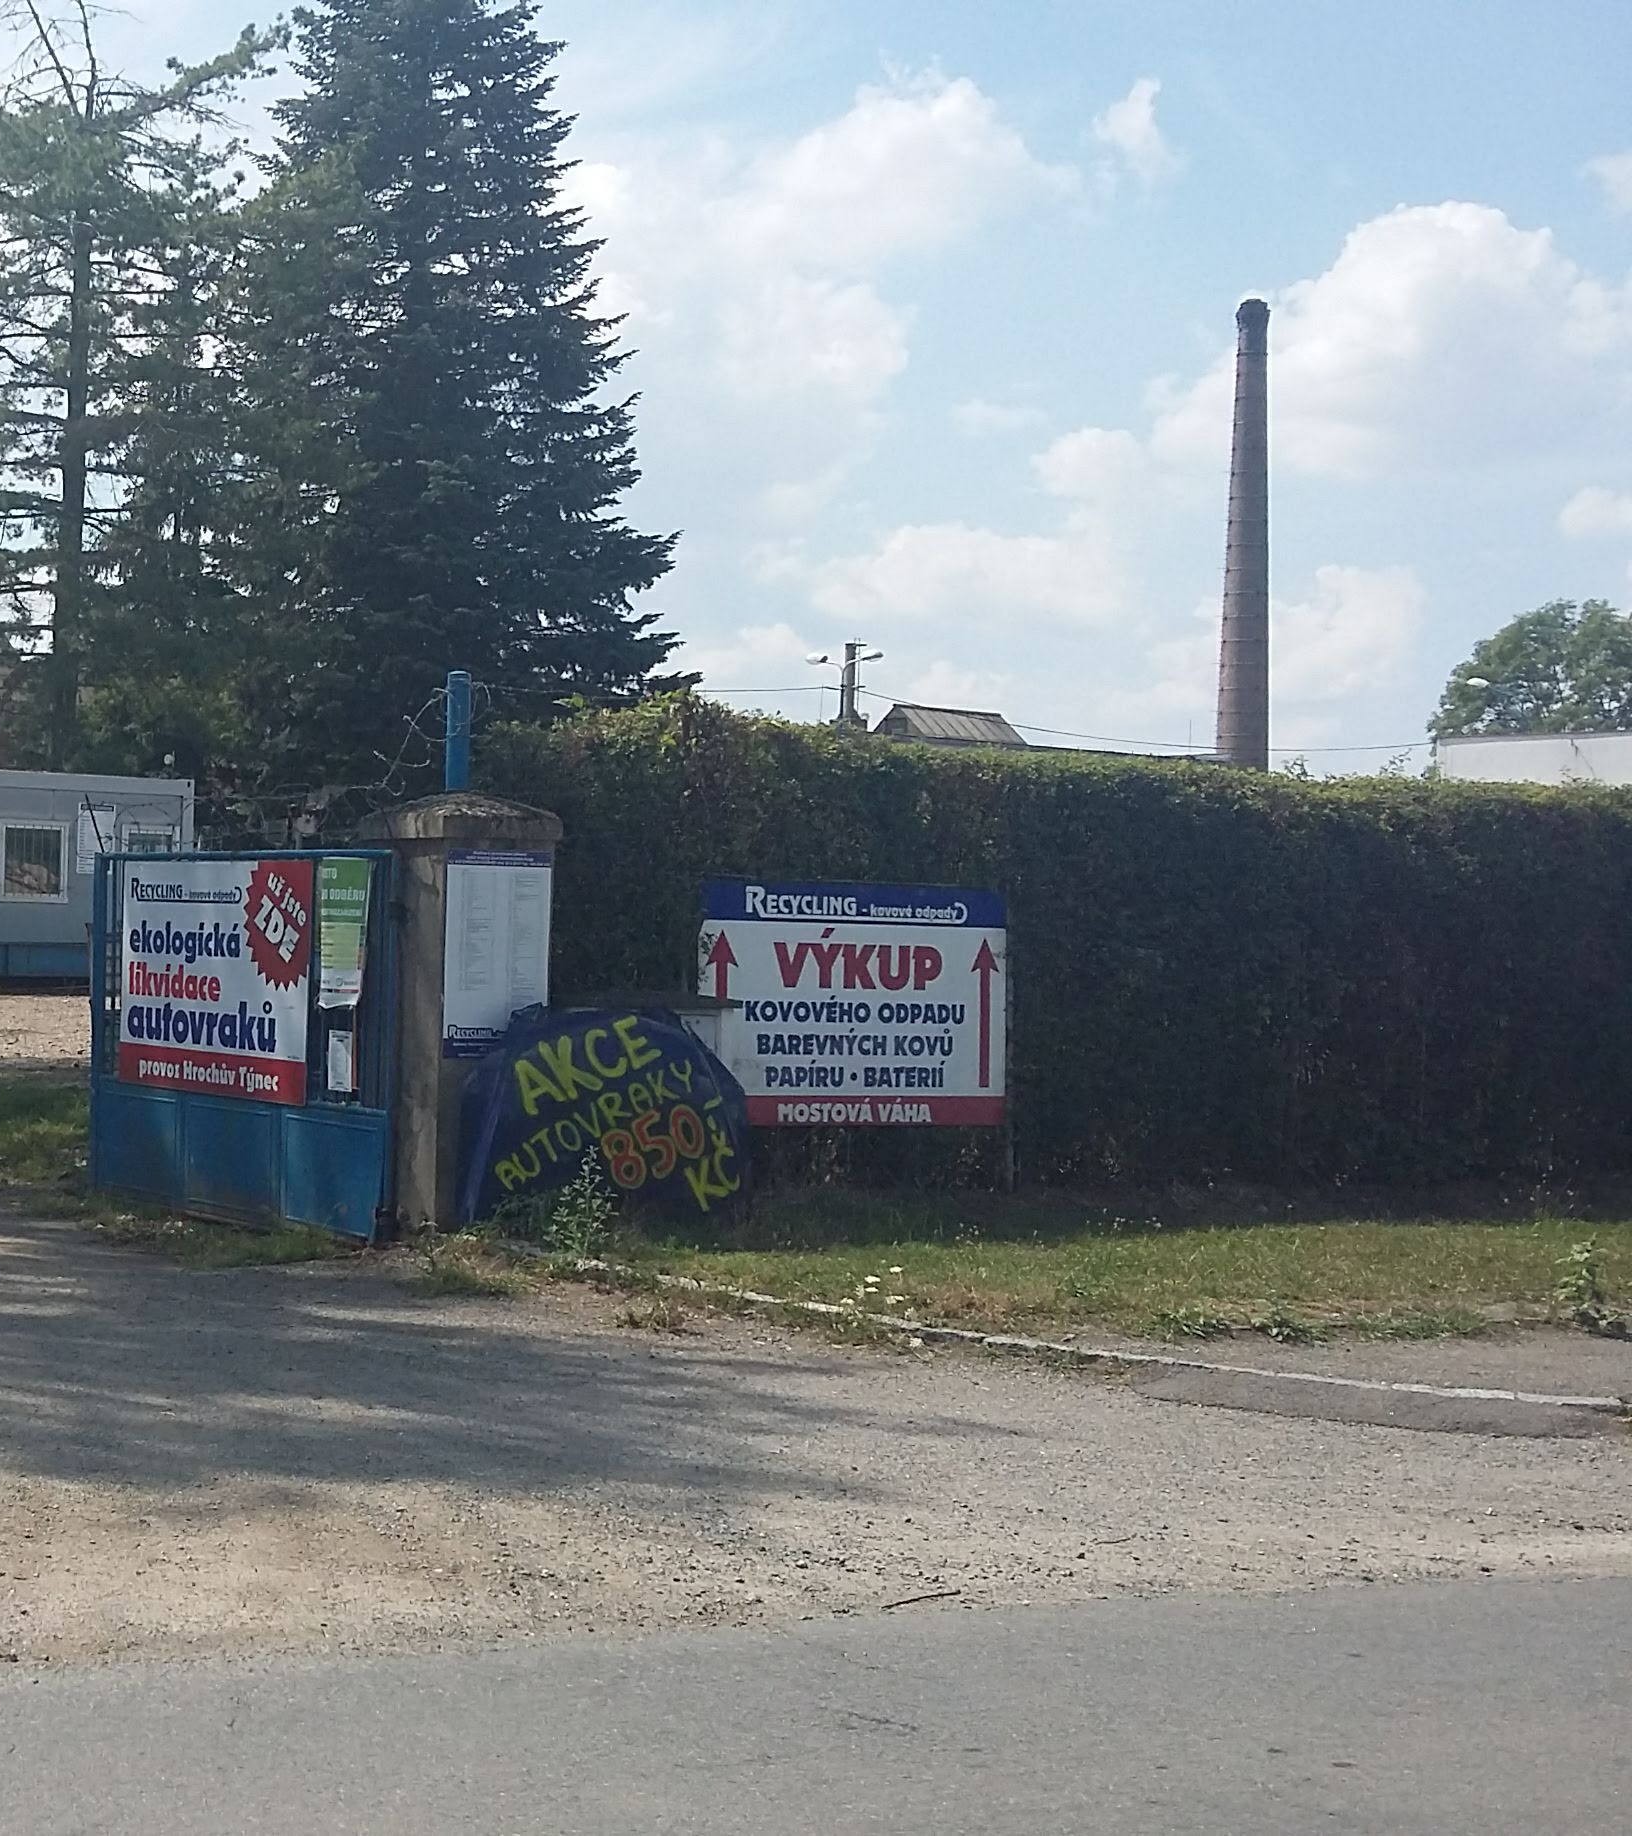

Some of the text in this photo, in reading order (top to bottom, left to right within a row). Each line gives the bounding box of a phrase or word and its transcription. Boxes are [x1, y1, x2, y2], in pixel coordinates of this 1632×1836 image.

[130, 877, 183, 899] RECYCLING
[280, 887, 306, 927] jste
[745, 885, 857, 917] RECYCLING
[915, 904, 959, 921] odpady
[129, 920, 241, 964] ekologická
[253, 894, 300, 963] ZDE
[773, 927, 943, 992] VÝKUP
[128, 961, 221, 1001] likvidace
[127, 1001, 277, 1053] autovraků
[744, 995, 965, 1025] KOVOVÉHO ODPADU
[756, 1027, 954, 1057] BAREVNÝCH KOVŮ
[138, 1058, 180, 1079] provoz
[239, 1066, 280, 1092] Týnec
[515, 1015, 662, 1116] AKCE
[764, 1059, 947, 1088] PAPÍRU BATERIÍ
[495, 1059, 692, 1190] AUTOVRAKY
[776, 1097, 932, 1123] MOSTOVÁ VÁHA
